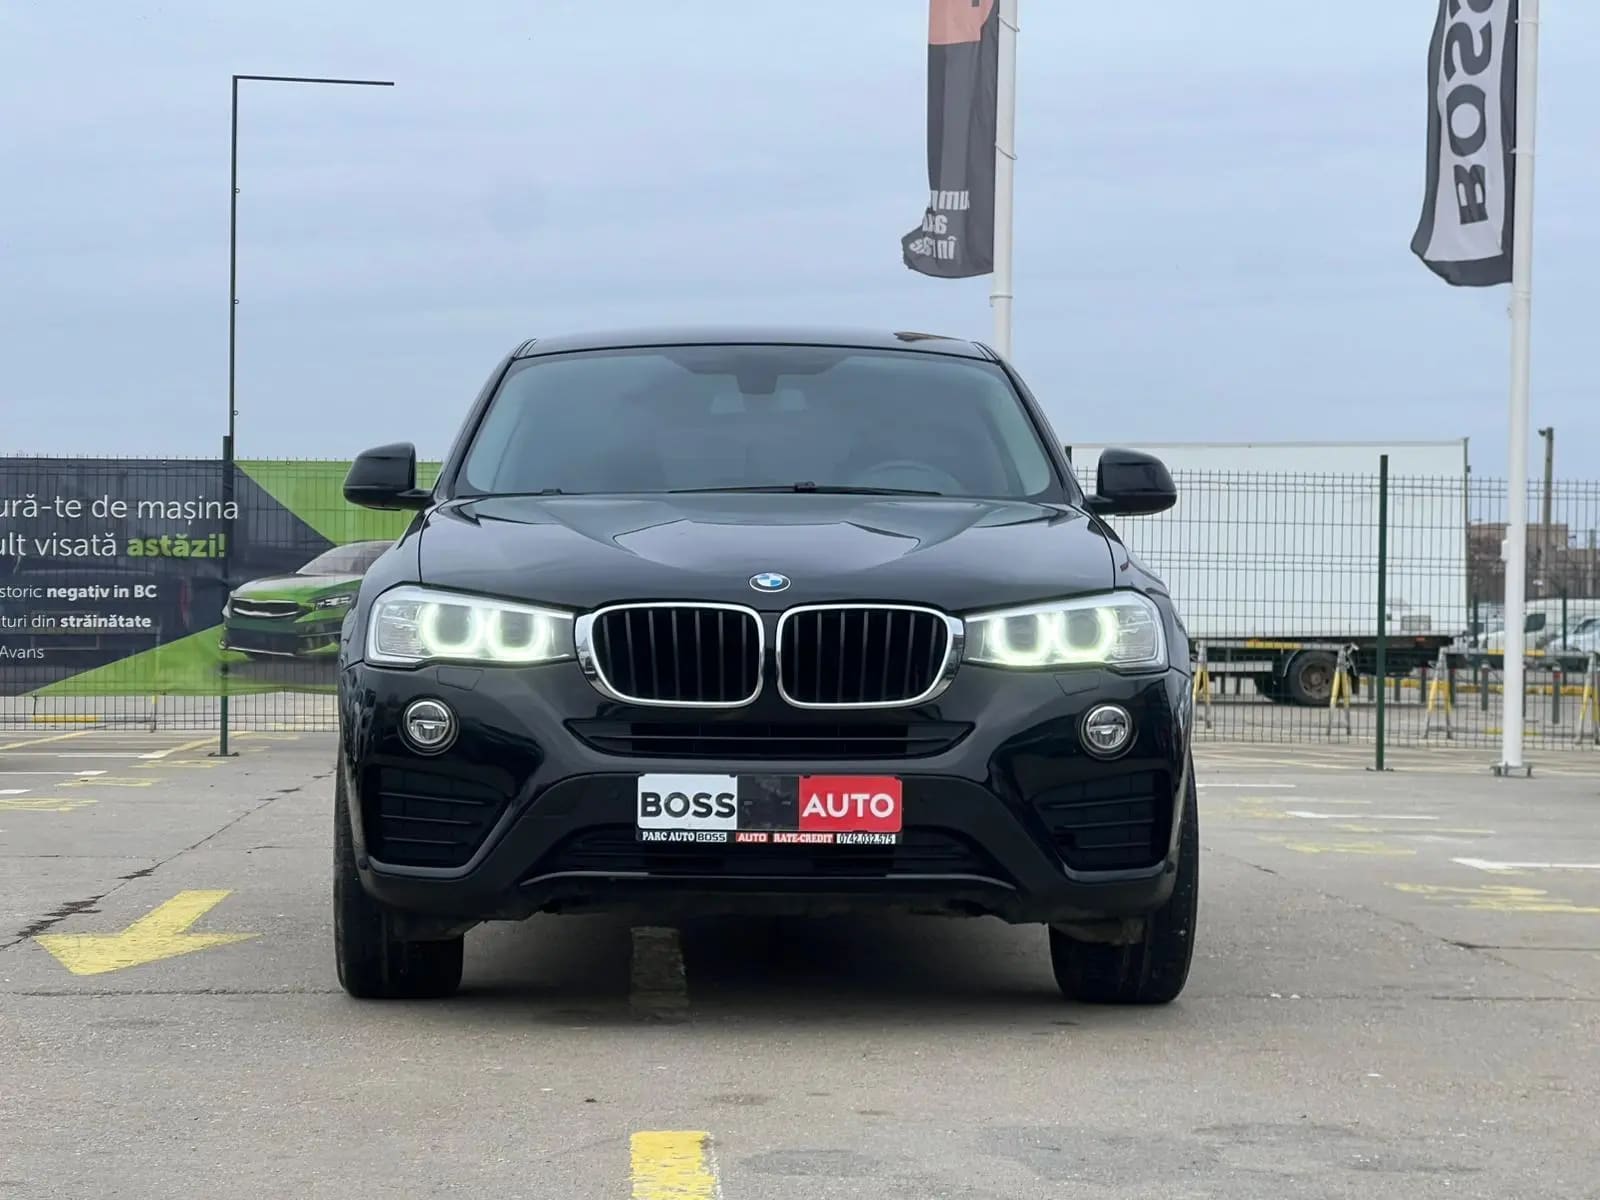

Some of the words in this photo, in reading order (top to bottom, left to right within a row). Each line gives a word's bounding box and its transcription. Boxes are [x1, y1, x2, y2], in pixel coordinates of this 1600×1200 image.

[92, 494, 127, 519] de
[137, 495, 239, 526] mașina
[34, 532, 117, 557] visată
[127, 533, 226, 558] astăzi!
[47, 584, 110, 601] negativ
[114, 585, 129, 599] in
[133, 585, 158, 599] BC
[31, 615, 55, 628] din
[60, 614, 152, 628] străinătate
[0, 645, 44, 660] Avans
[640, 791, 736, 819] BOSS
[802, 792, 895, 818] AUTO
[642, 831, 668, 842] PARC
[668, 832, 695, 842] AUTO
[697, 833, 727, 842] BOSS
[738, 832, 767, 842] AUTO
